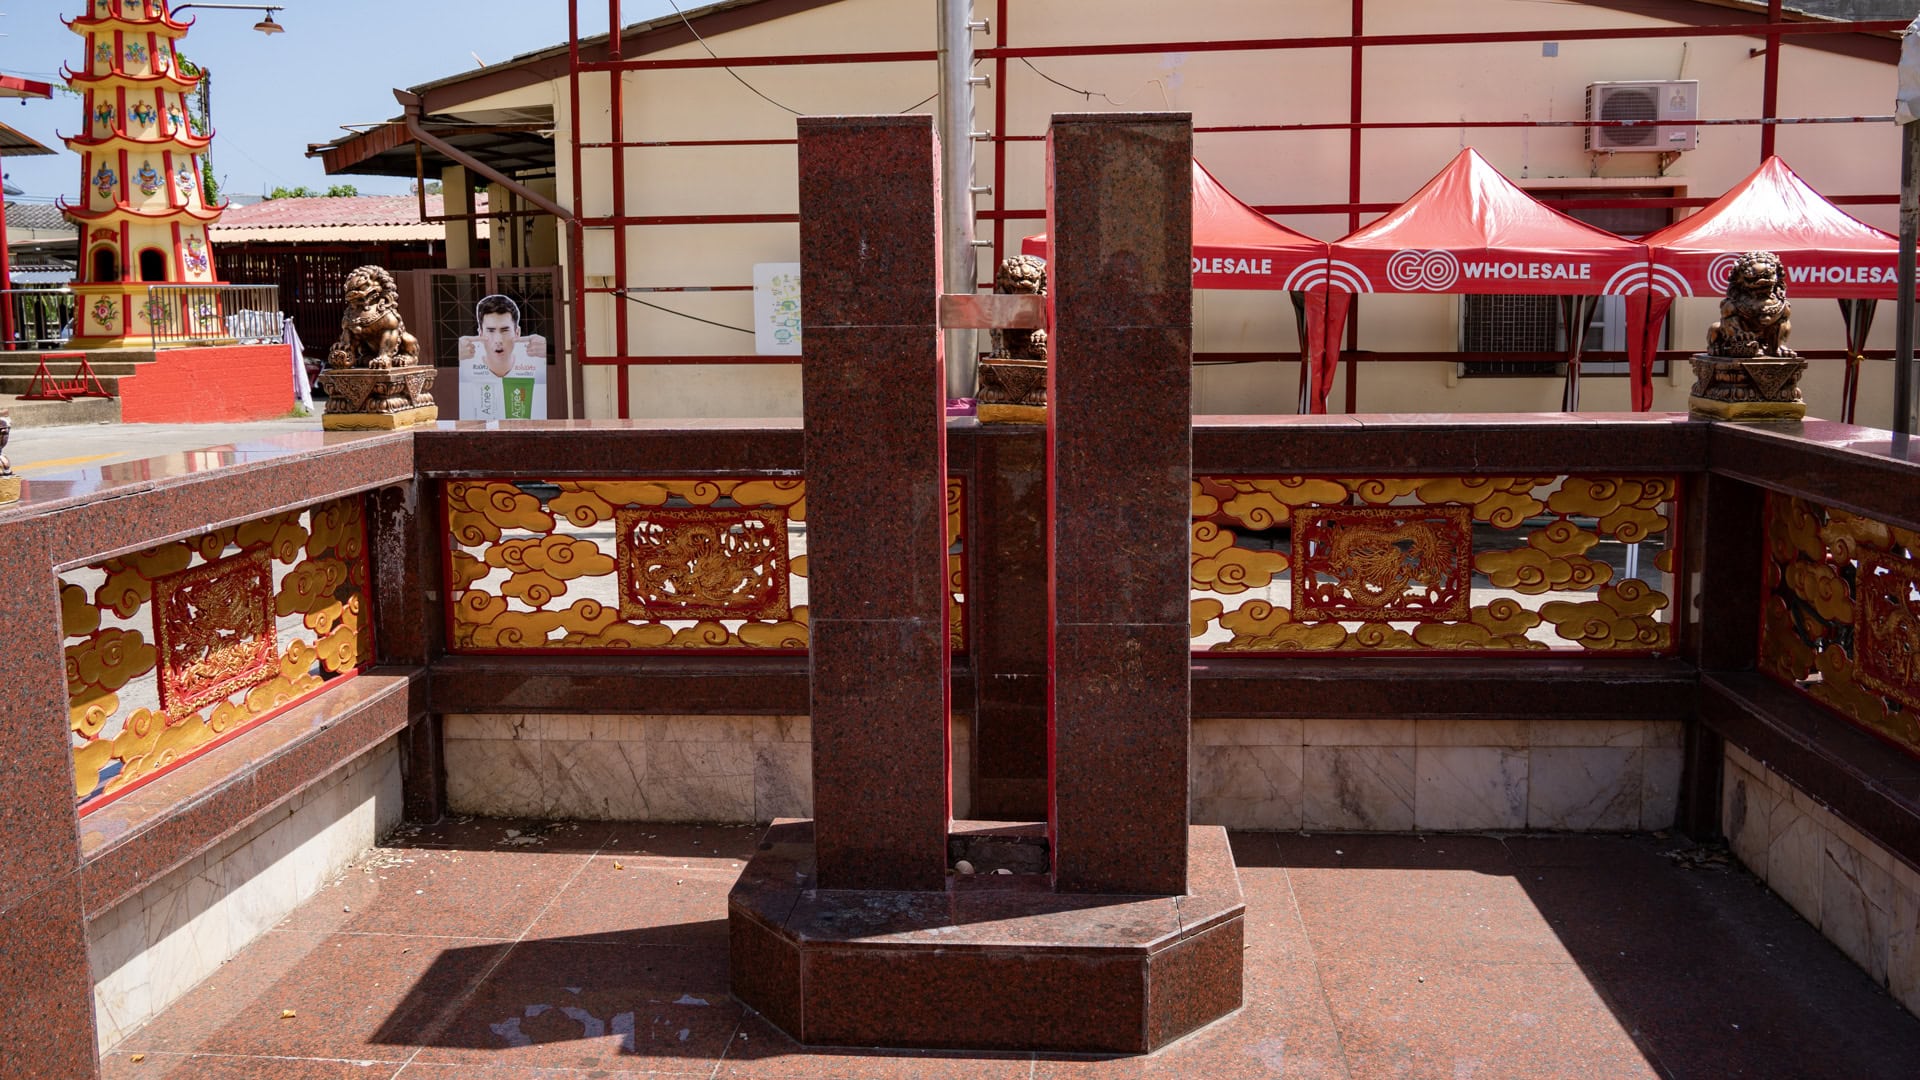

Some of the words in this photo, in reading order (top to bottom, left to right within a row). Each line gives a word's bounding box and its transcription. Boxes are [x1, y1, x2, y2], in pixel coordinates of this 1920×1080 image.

[1193, 257, 1272, 275] LESALE
[1386, 249, 1459, 291] GO
[1463, 262, 1591, 280] WHOLESALE
[1788, 266, 1920, 283] WHOLESA
